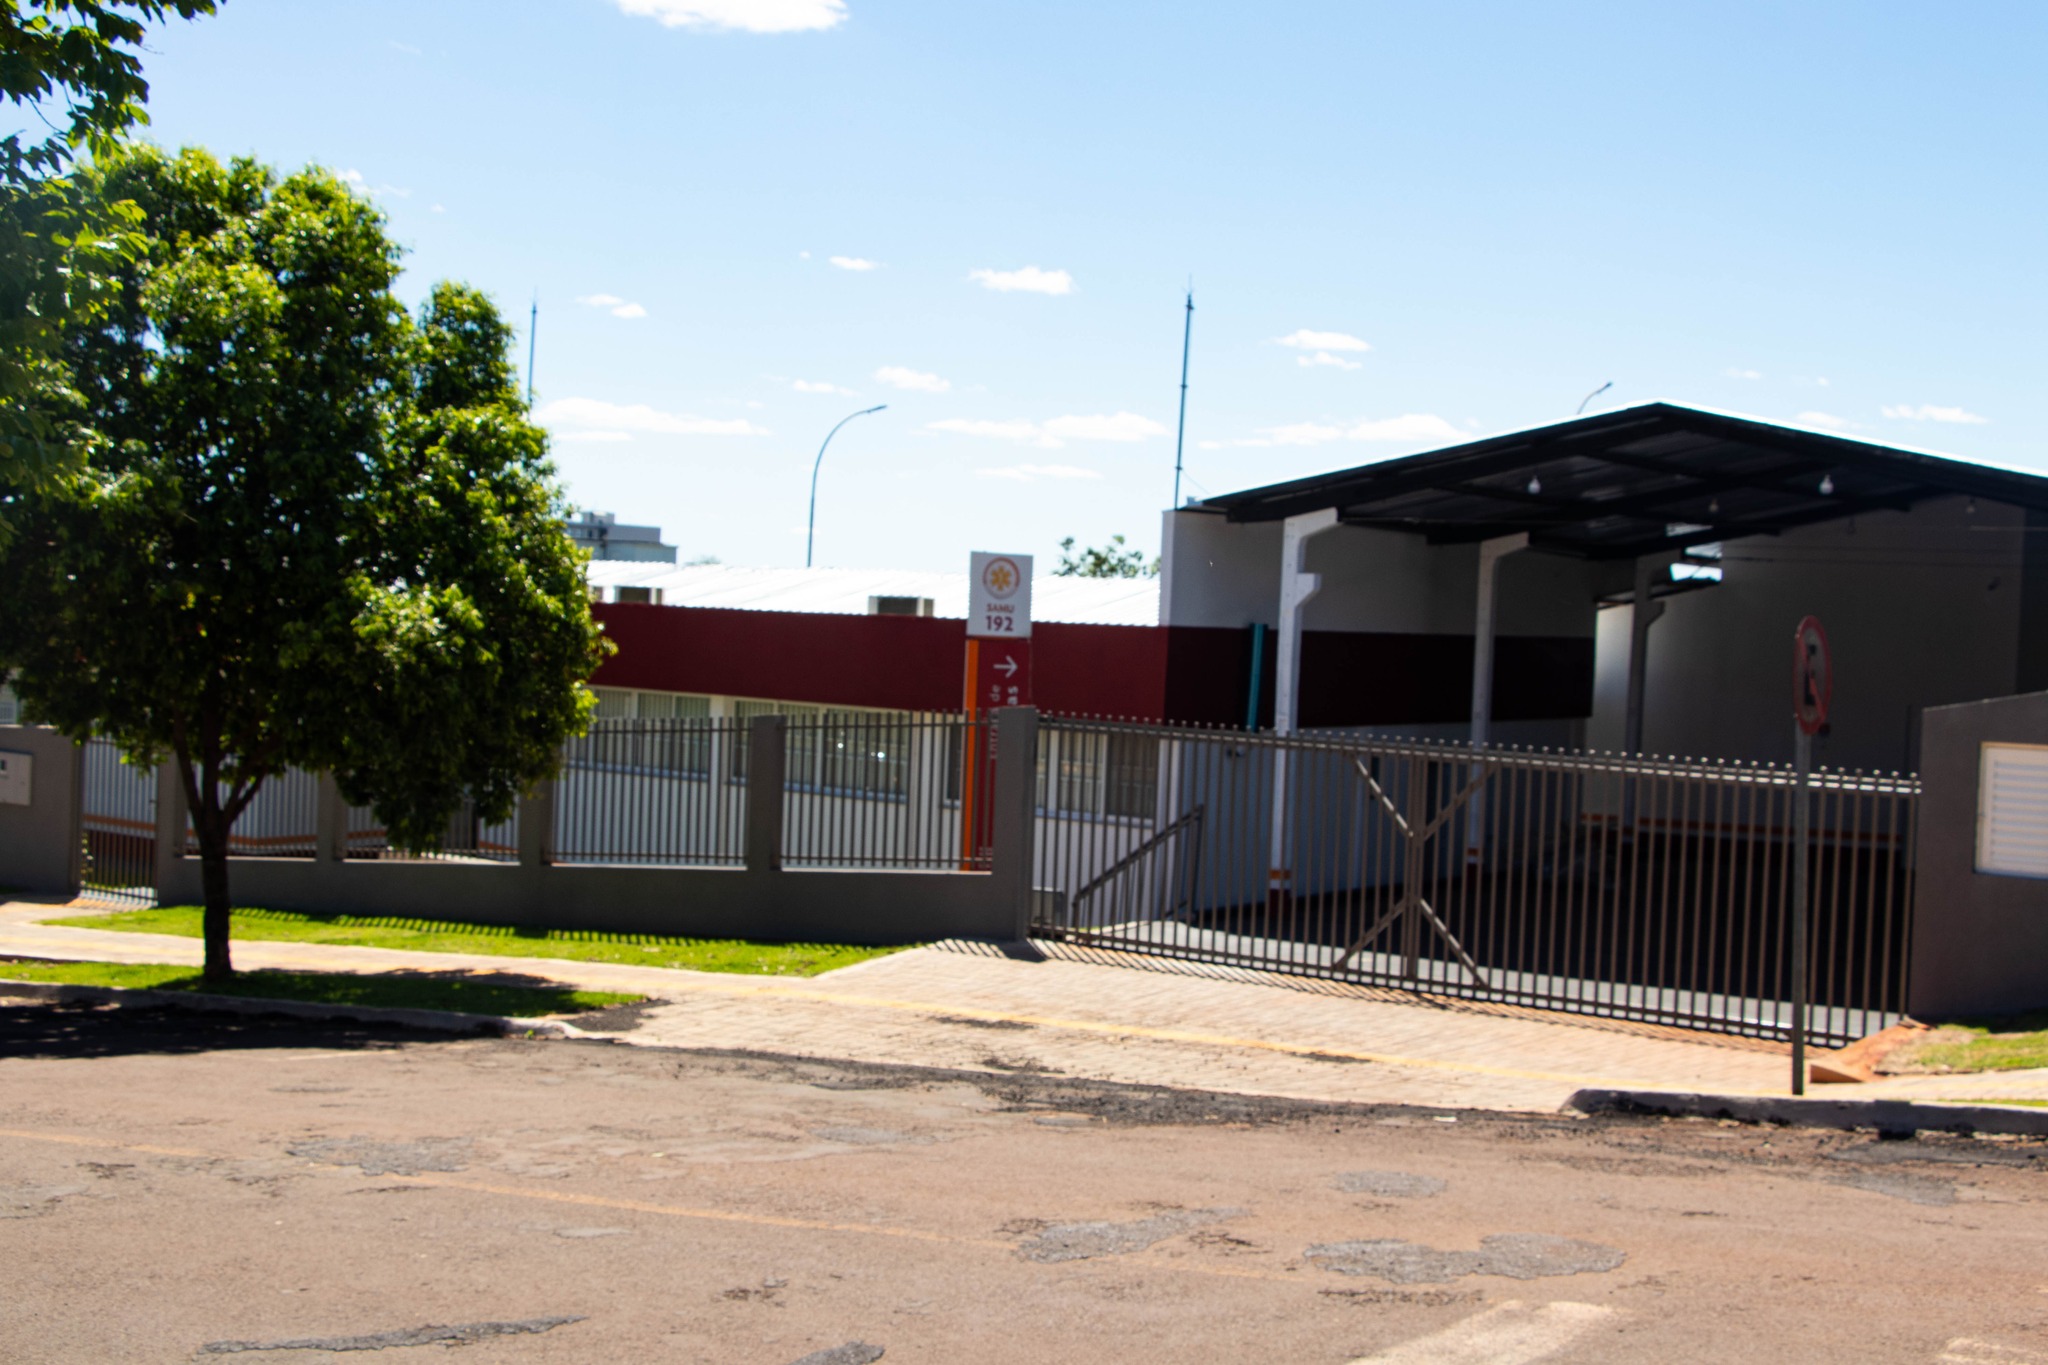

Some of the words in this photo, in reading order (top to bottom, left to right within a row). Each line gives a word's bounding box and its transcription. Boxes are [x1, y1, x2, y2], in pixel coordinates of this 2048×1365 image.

[986, 603, 1015, 613] SAMU
[986, 615, 1014, 632] 192
[989, 684, 1001, 703] de
